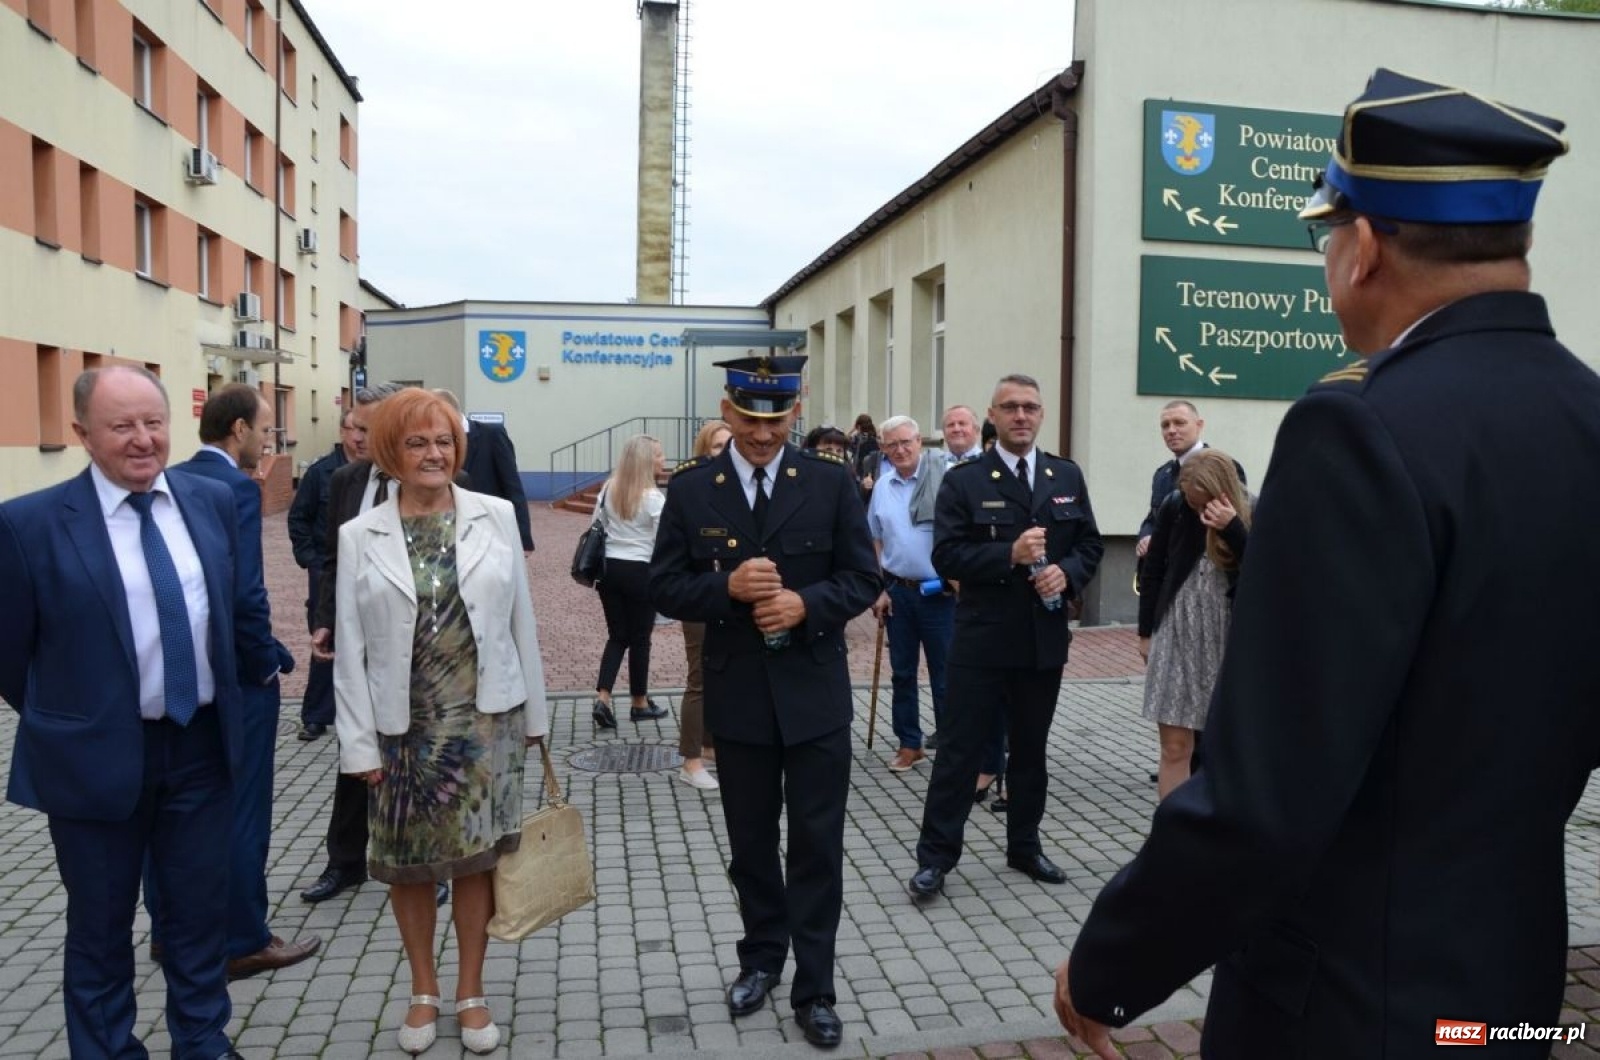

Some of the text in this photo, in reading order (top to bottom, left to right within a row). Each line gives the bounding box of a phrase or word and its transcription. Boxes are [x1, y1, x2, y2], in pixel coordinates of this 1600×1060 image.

[1239, 124, 1337, 152] Powiatow
[1177, 282, 1336, 317] Terenowy Pu
[563, 331, 643, 346] Powiatowe
[1200, 322, 1347, 357] Paszportowy
[563, 350, 673, 368] Konferencyjne
